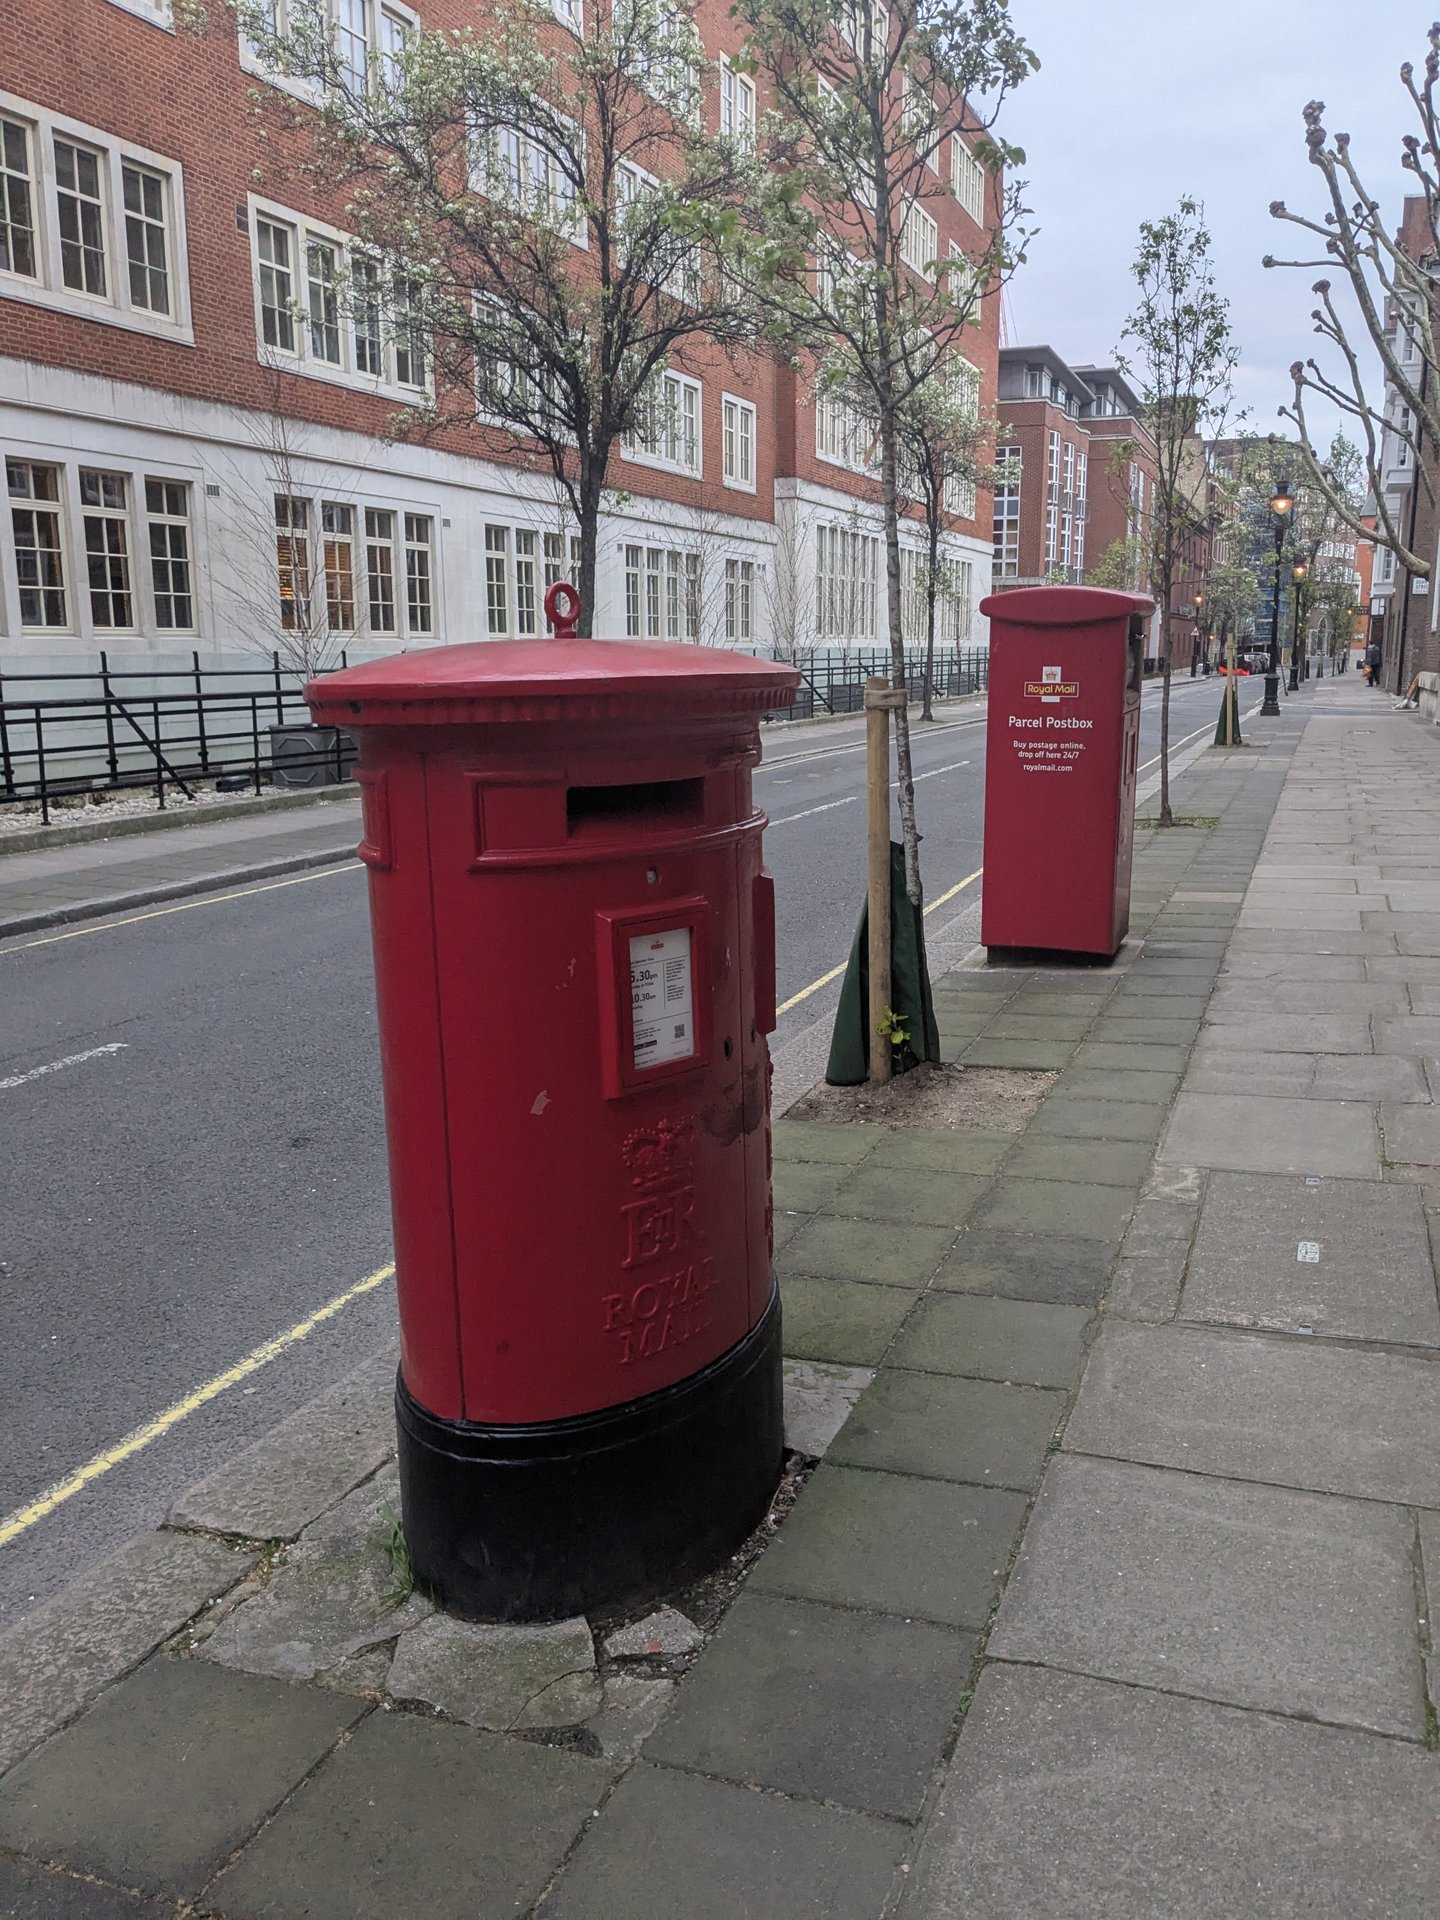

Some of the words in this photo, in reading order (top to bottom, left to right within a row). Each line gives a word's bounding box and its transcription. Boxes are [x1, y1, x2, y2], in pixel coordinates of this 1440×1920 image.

[1028, 684, 1052, 694] Royal
[1054, 685, 1076, 694] Mail
[1008, 716, 1042, 728] Parcel
[1046, 717, 1093, 729] Postbox
[1013, 741, 1027, 750] Buy
[1028, 742, 1058, 750] postage
[1060, 742, 1086, 750] online,
[1018, 751, 1033, 759] drop
[1062, 751, 1079, 759] 24/7
[1023, 763, 1073, 772] royalmail.com
[602, 1256, 718, 1331] ROYAL
